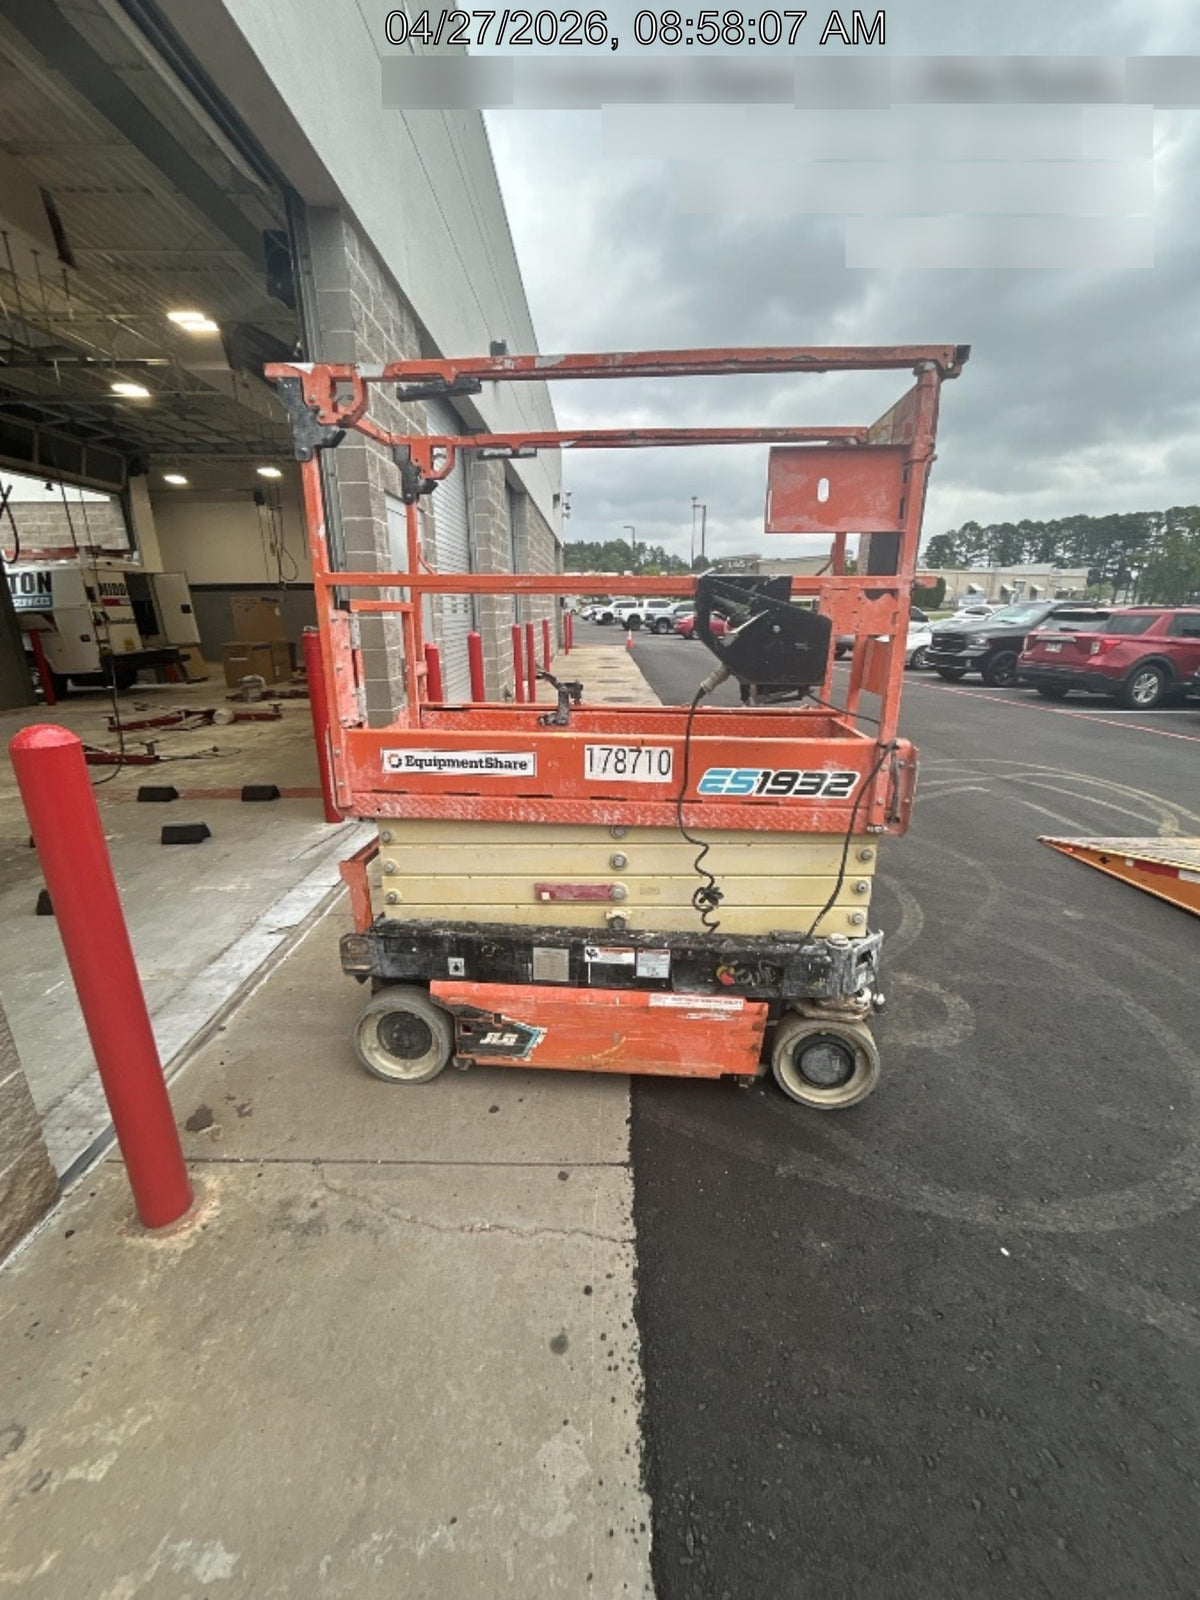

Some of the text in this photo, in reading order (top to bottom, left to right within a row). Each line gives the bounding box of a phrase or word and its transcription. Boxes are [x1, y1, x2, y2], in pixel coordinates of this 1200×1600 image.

[6, 572, 52, 595] TON
[404, 754, 528, 770] EquipmentShare
[586, 747, 672, 776] 178710
[699, 768, 860, 798] ES1932
[480, 1032, 518, 1046] JLG
